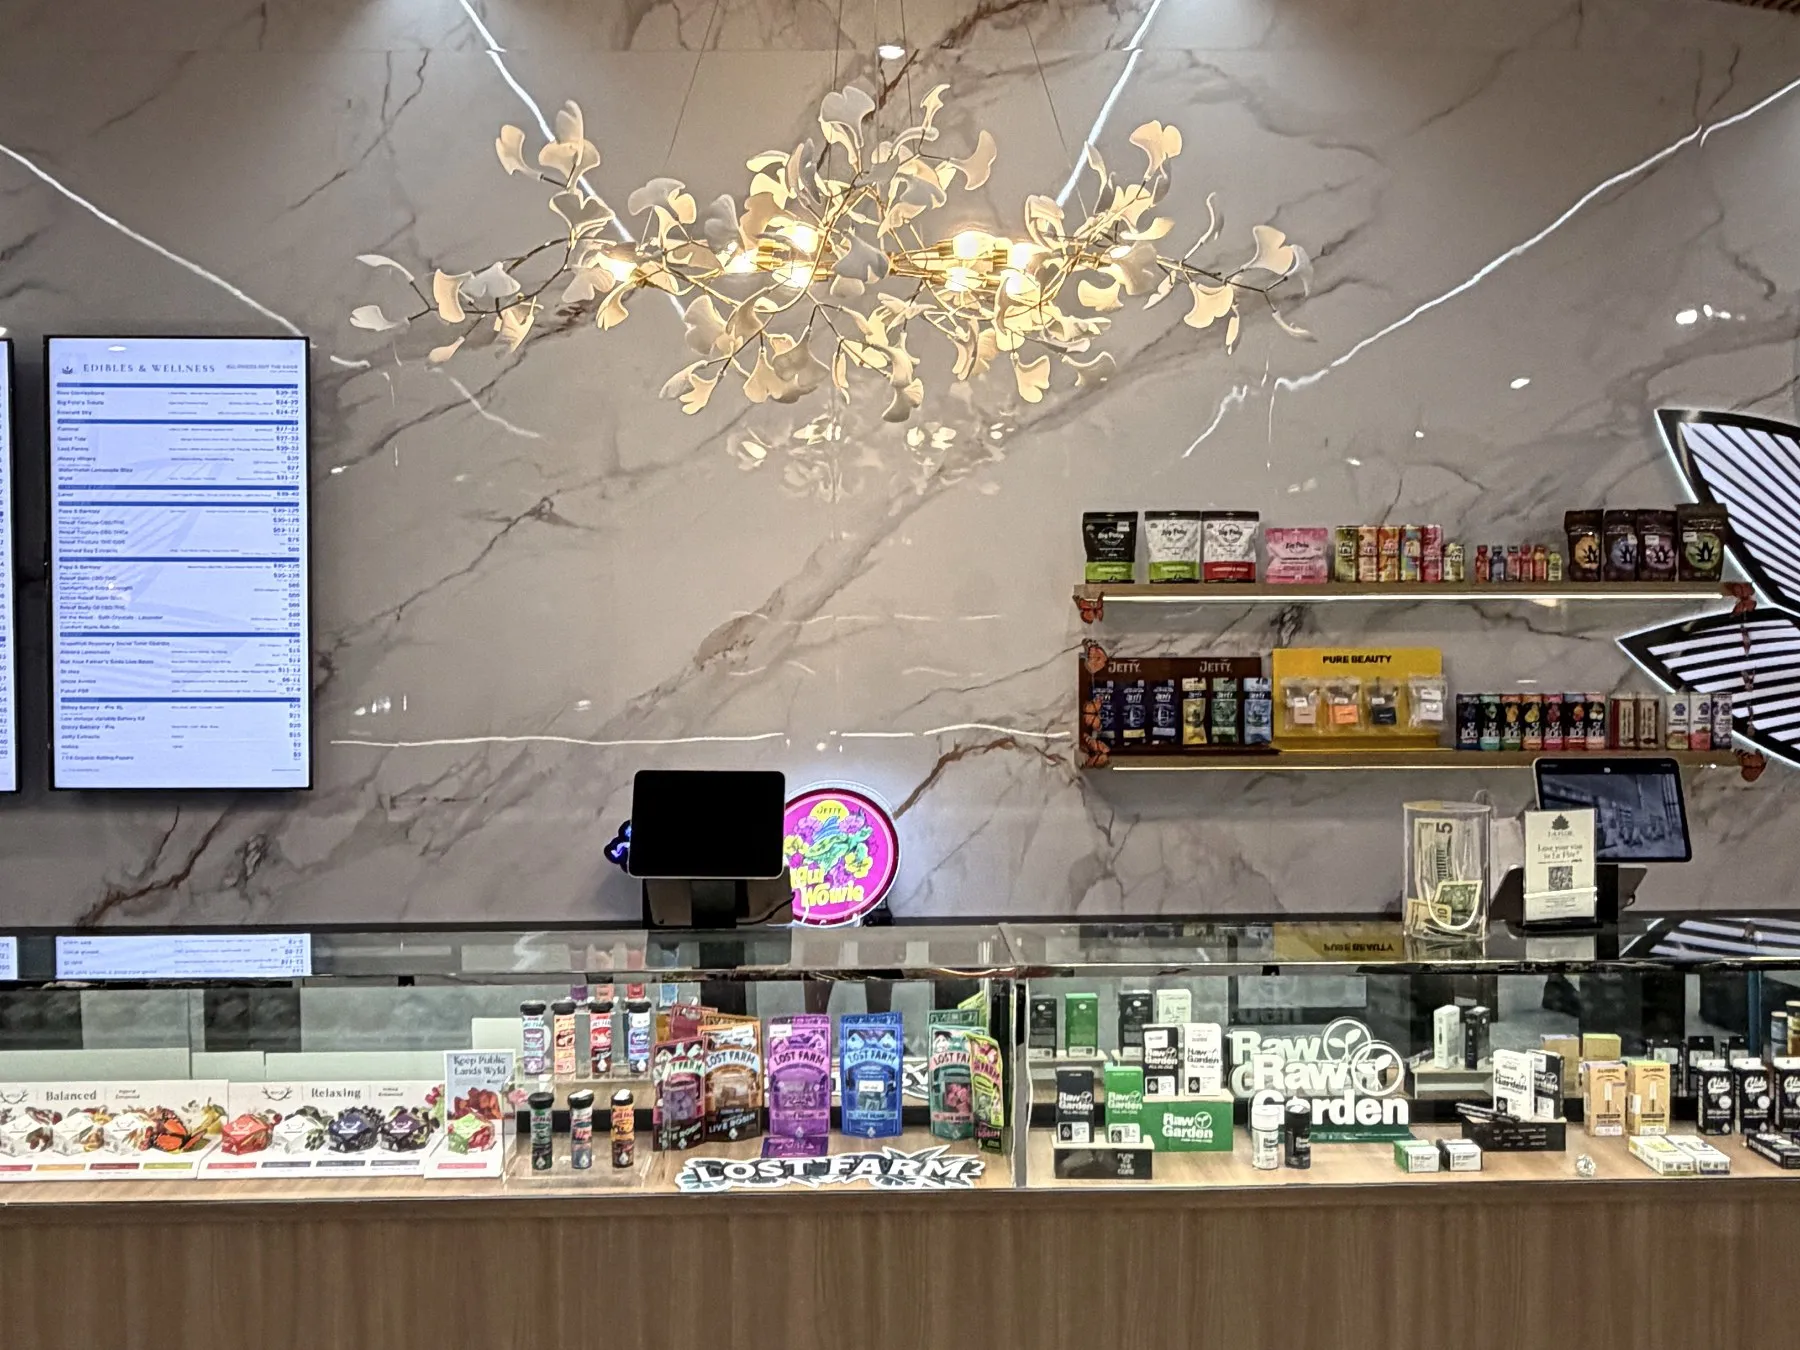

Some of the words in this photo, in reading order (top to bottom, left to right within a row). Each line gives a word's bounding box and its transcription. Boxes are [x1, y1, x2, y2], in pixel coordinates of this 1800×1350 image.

[83, 364, 134, 372] EDIBLES
[139, 364, 147, 372] &
[152, 364, 215, 373] WELLNESS
[1322, 656, 1349, 664] PURE
[1351, 655, 1392, 664] BEAUTY
[1436, 822, 1453, 833] 5
[1187, 1047, 1207, 1055] Raw
[1231, 1030, 1321, 1064] Raw
[453, 1055, 476, 1066] Keep
[479, 1054, 506, 1064] Public
[706, 1051, 726, 1069] LOST
[728, 1050, 756, 1065] FARM
[774, 1051, 797, 1066] LOST
[799, 1050, 825, 1066] FARM
[848, 1053, 869, 1064] LOST
[871, 1053, 896, 1064] FARM
[934, 1055, 954, 1065] LOST
[1145, 1056, 1178, 1066] Garden
[1187, 1055, 1219, 1064] Garden
[454, 1067, 482, 1075] Lands
[484, 1066, 506, 1076] Wyld
[1252, 1054, 1348, 1090] Raw
[46, 1090, 96, 1101] Balanced
[311, 1087, 361, 1099] Relaxing
[1059, 1092, 1081, 1101] Raw
[1108, 1092, 1130, 1101] Raw
[1059, 1100, 1093, 1110] Garden
[1108, 1100, 1142, 1110] Garden
[1163, 1112, 1194, 1126] Raw
[708, 1123, 727, 1133] LIVE
[1162, 1125, 1213, 1138] Garden
[699, 1159, 807, 1183] LOST
[830, 1157, 974, 1178] FARM
